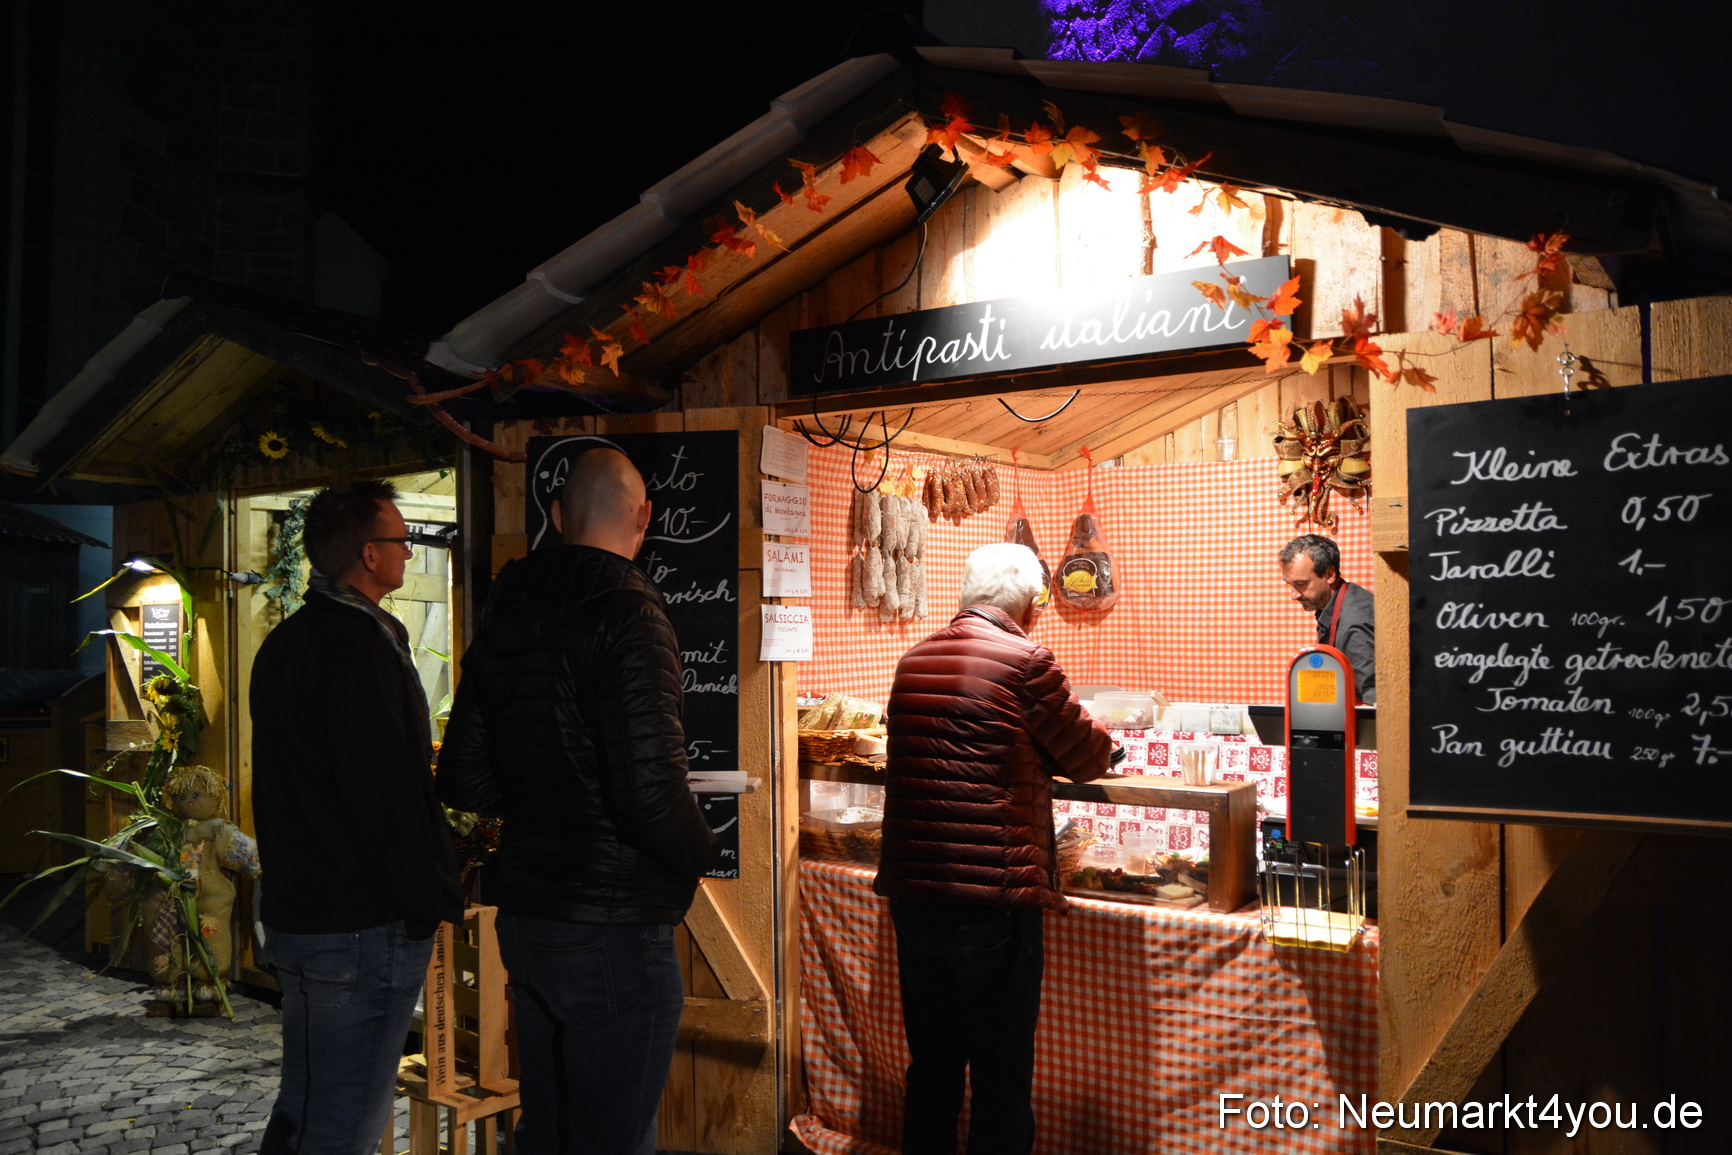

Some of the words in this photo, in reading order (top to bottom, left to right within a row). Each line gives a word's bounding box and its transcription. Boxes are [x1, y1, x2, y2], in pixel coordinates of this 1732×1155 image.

[814, 304, 1011, 383] Antipasti
[1040, 276, 1246, 350] italiani
[1450, 446, 1579, 486] Kleine
[1603, 432, 1731, 472] Extras
[764, 493, 807, 506] FORMAGGIO
[774, 506, 807, 520] Montagna
[1424, 501, 1568, 537] Pizzetta
[1621, 493, 1713, 532] 0,50
[766, 549, 805, 564] SALAMI
[1429, 548, 1556, 582] Taralli
[764, 613, 810, 625] SALSICCIA
[1436, 600, 1550, 630] Oliven
[1646, 595, 1732, 629] 1,50
[680, 639, 730, 664] mit
[1434, 642, 1555, 687] eingelegte
[1475, 686, 1616, 715] Tomaten
[1681, 691, 1732, 727] 2,5
[1431, 723, 1487, 757] Pan
[1498, 727, 1614, 768] guttiau
[433, 970, 446, 1029] deutschen
[437, 1033, 447, 1054] aus
[435, 1057, 447, 1087] Wein
